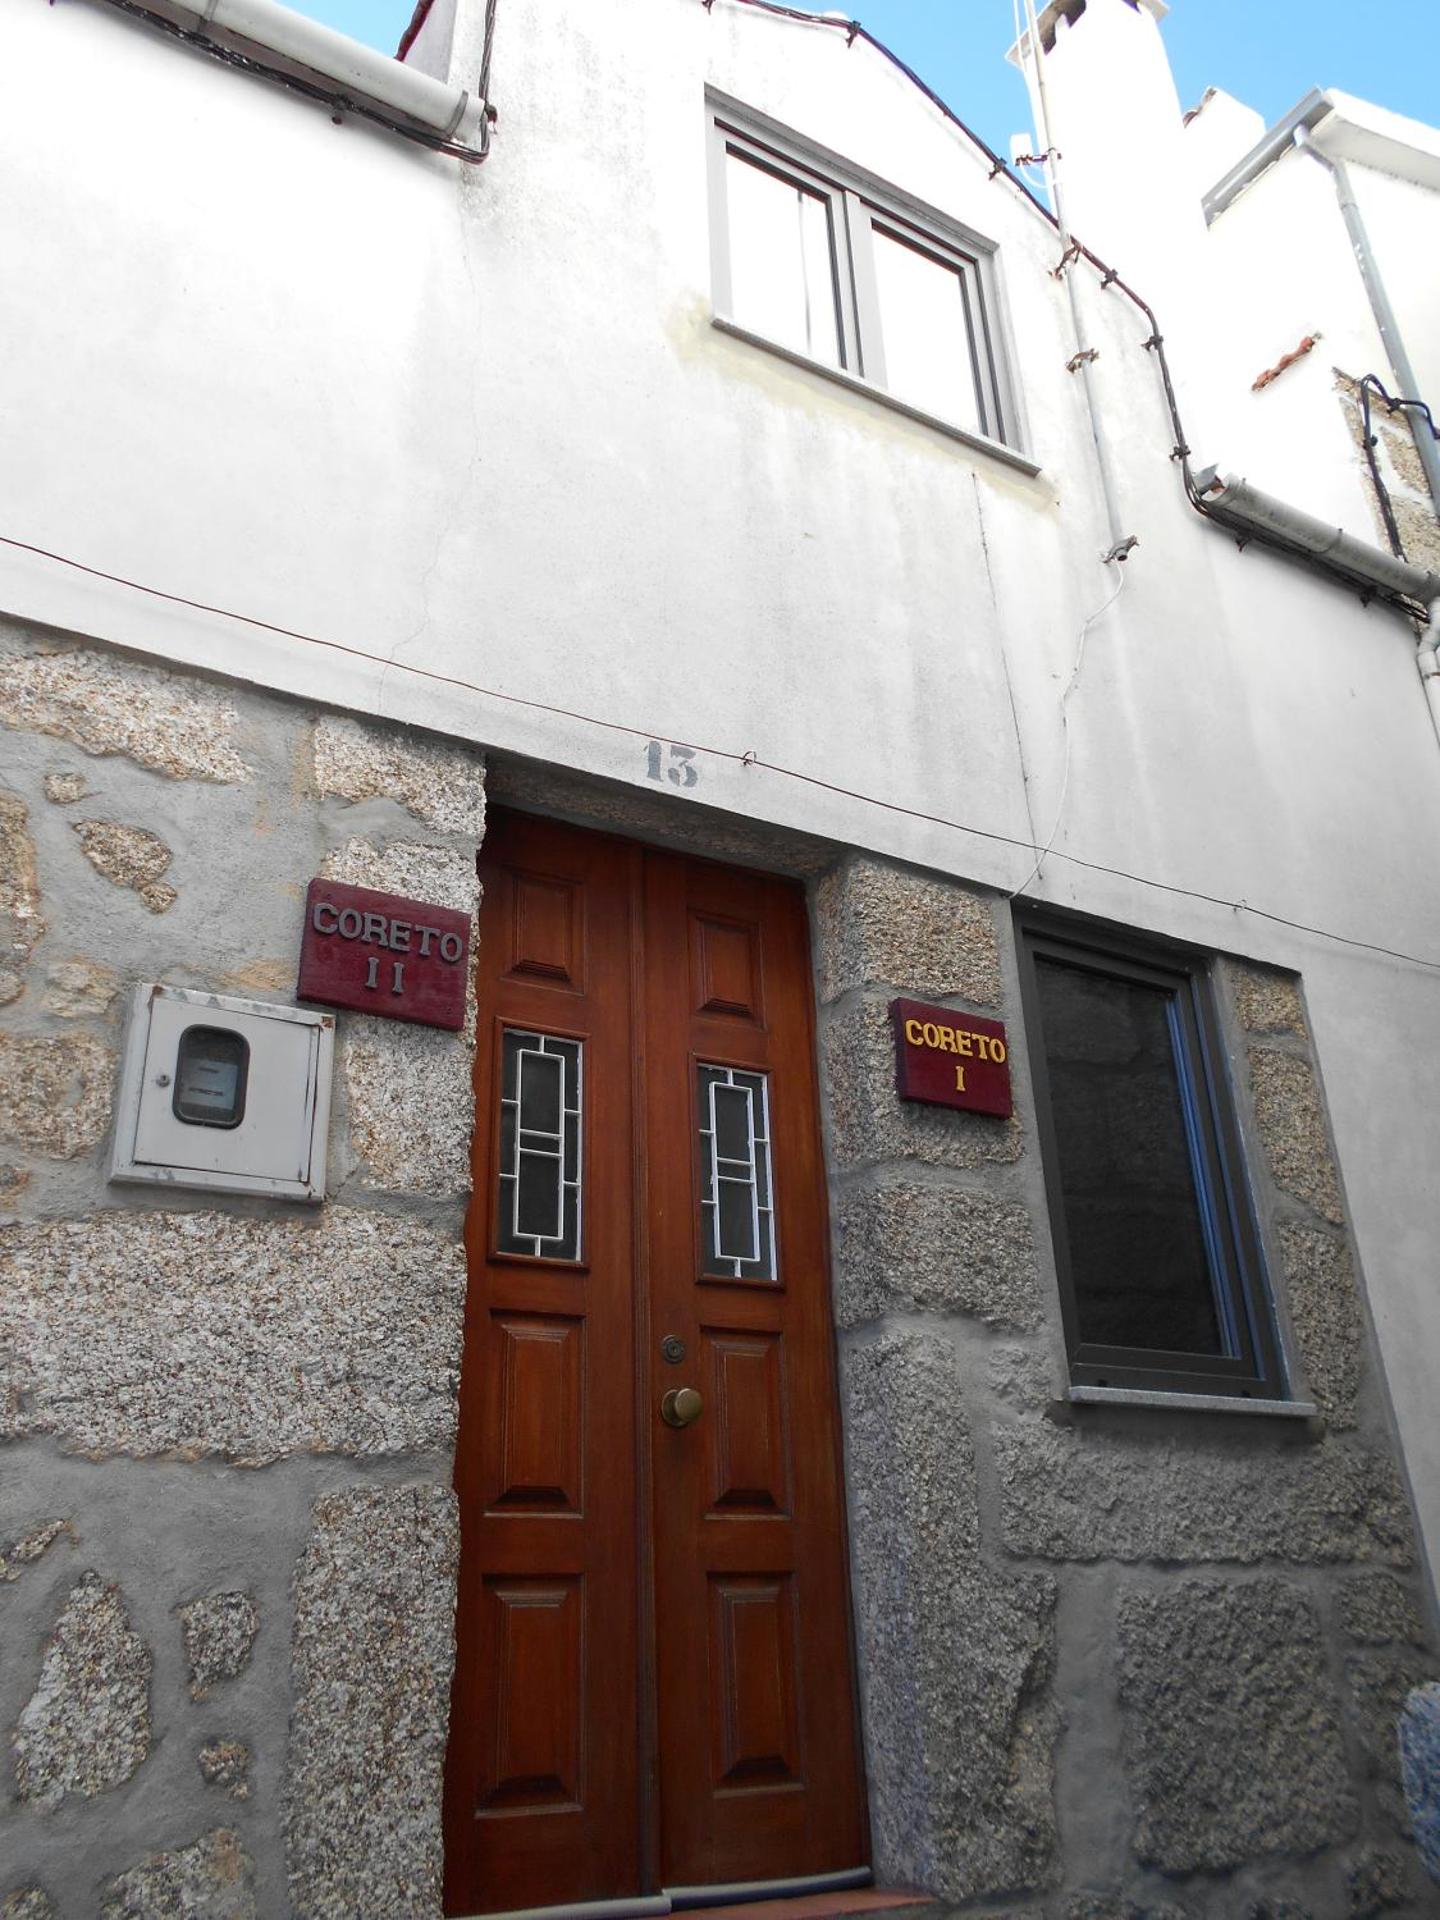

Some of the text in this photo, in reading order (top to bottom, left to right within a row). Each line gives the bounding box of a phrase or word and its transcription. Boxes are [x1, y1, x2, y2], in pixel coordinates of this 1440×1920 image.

[643, 740, 698, 788] 13
[313, 902, 463, 963] CORETO
[905, 1019, 1006, 1063] CORETO
